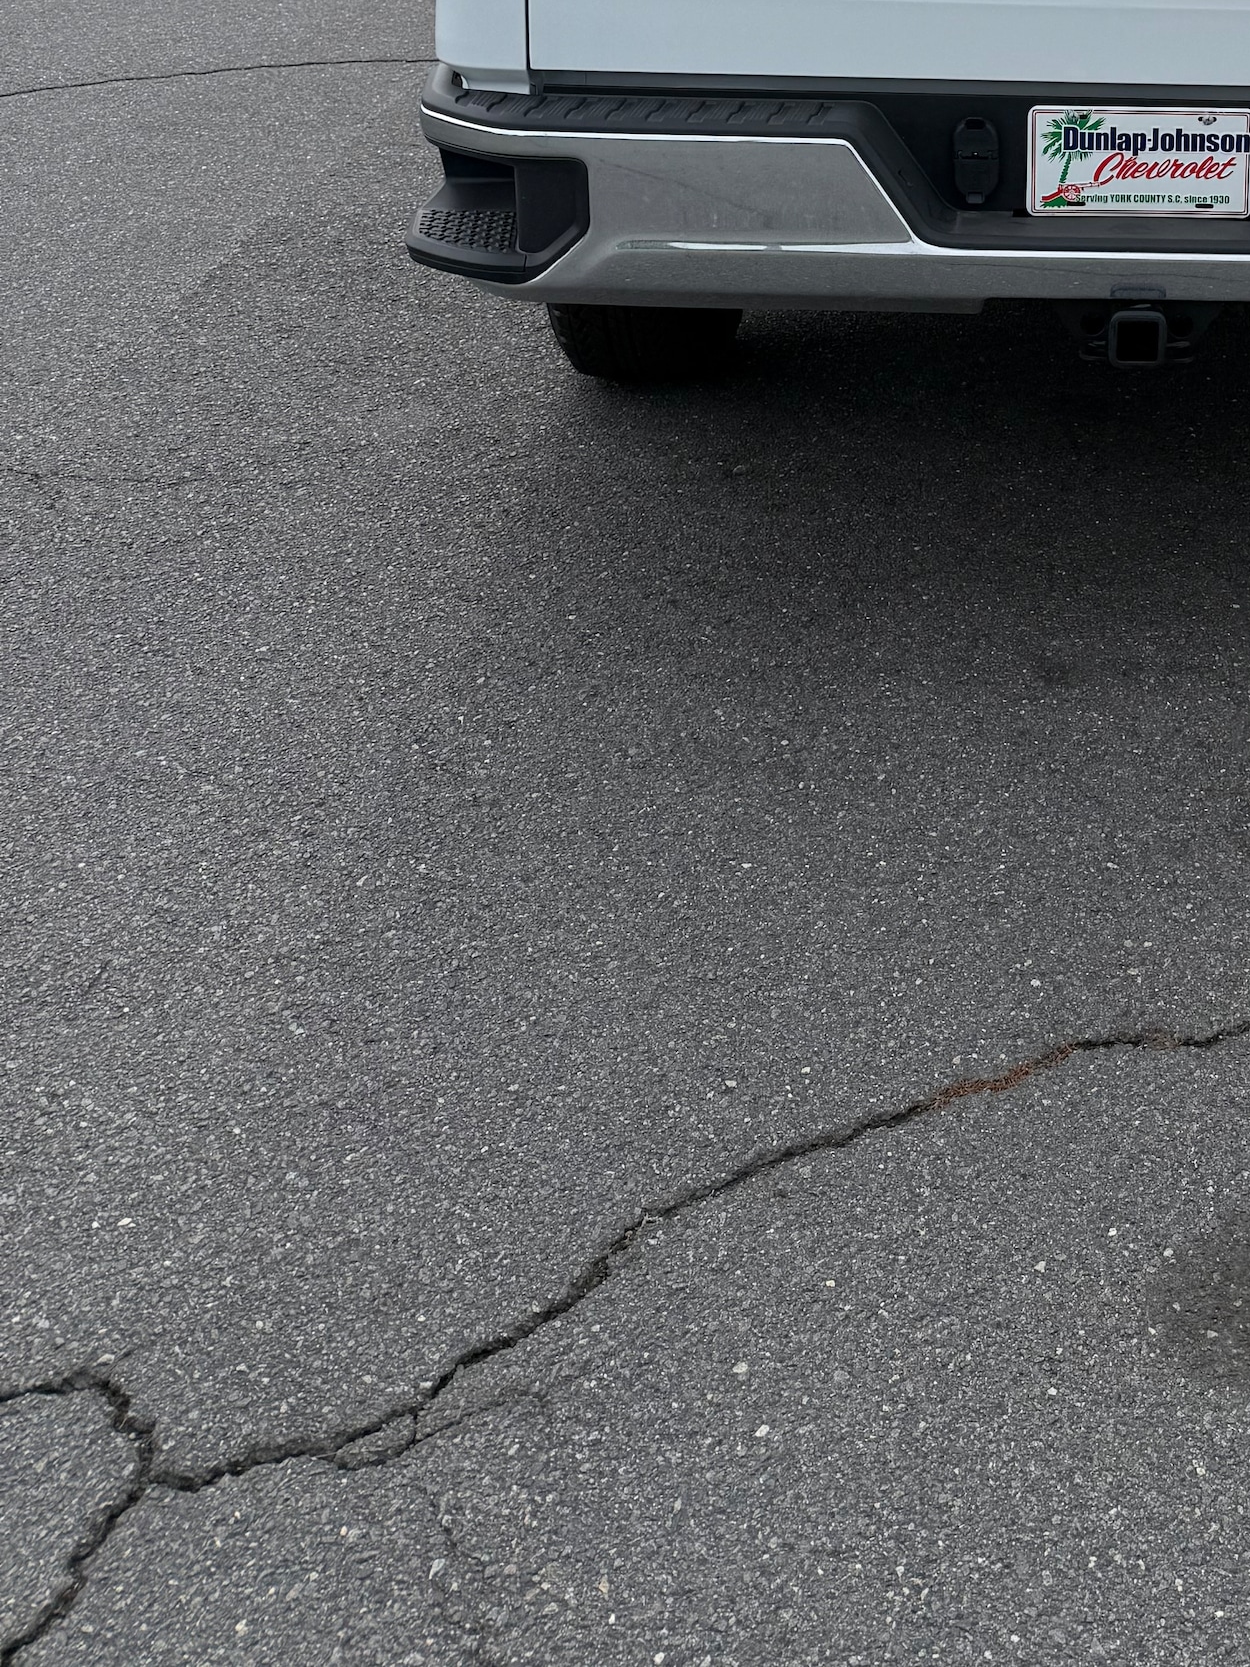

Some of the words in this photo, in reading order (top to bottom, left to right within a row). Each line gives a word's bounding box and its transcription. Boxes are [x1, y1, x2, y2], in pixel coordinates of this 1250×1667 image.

[1063, 127, 1250, 156] Dunlap-Johnson
[1093, 152, 1237, 186] Chevrolet
[1076, 193, 1108, 204] Serving
[1110, 194, 1131, 202] YORK
[1133, 194, 1166, 203] COUNTY
[1184, 194, 1208, 203] since
[1210, 195, 1230, 204] 1930
